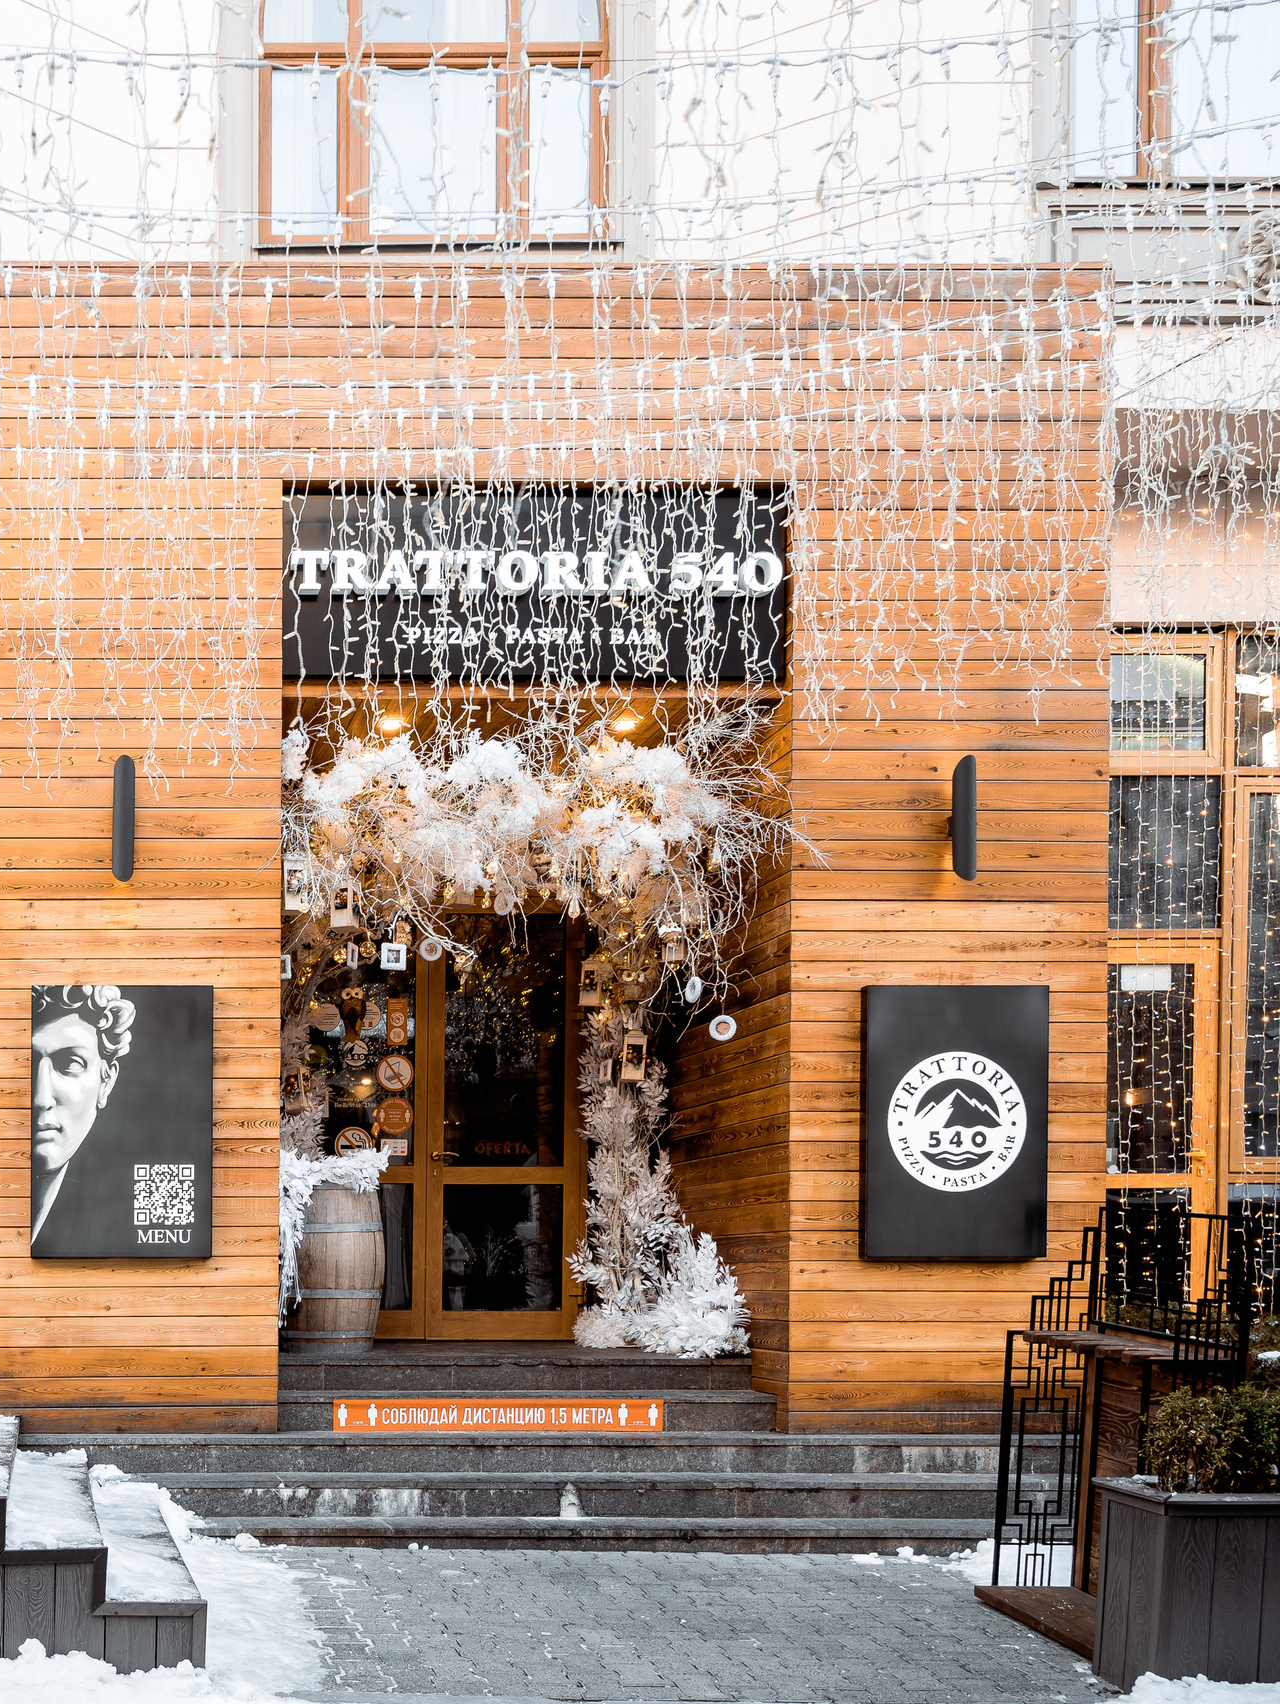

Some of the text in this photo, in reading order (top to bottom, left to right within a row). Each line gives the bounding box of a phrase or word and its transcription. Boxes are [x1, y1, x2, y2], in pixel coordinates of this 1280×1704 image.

[290, 549, 784, 599] TRATTORIA 540
[407, 626, 659, 645] PIZZA PASTA BAR
[893, 1056, 1021, 1114] TRATTORIA
[928, 1130, 987, 1148] 540
[898, 1134, 1017, 1188] PIZZA PASTA BAR
[137, 1229, 192, 1244] MENU
[381, 1404, 614, 1427] СОБЛЮДАЙ ДИСТАНЦИЮ 1,5 МЕТРА
